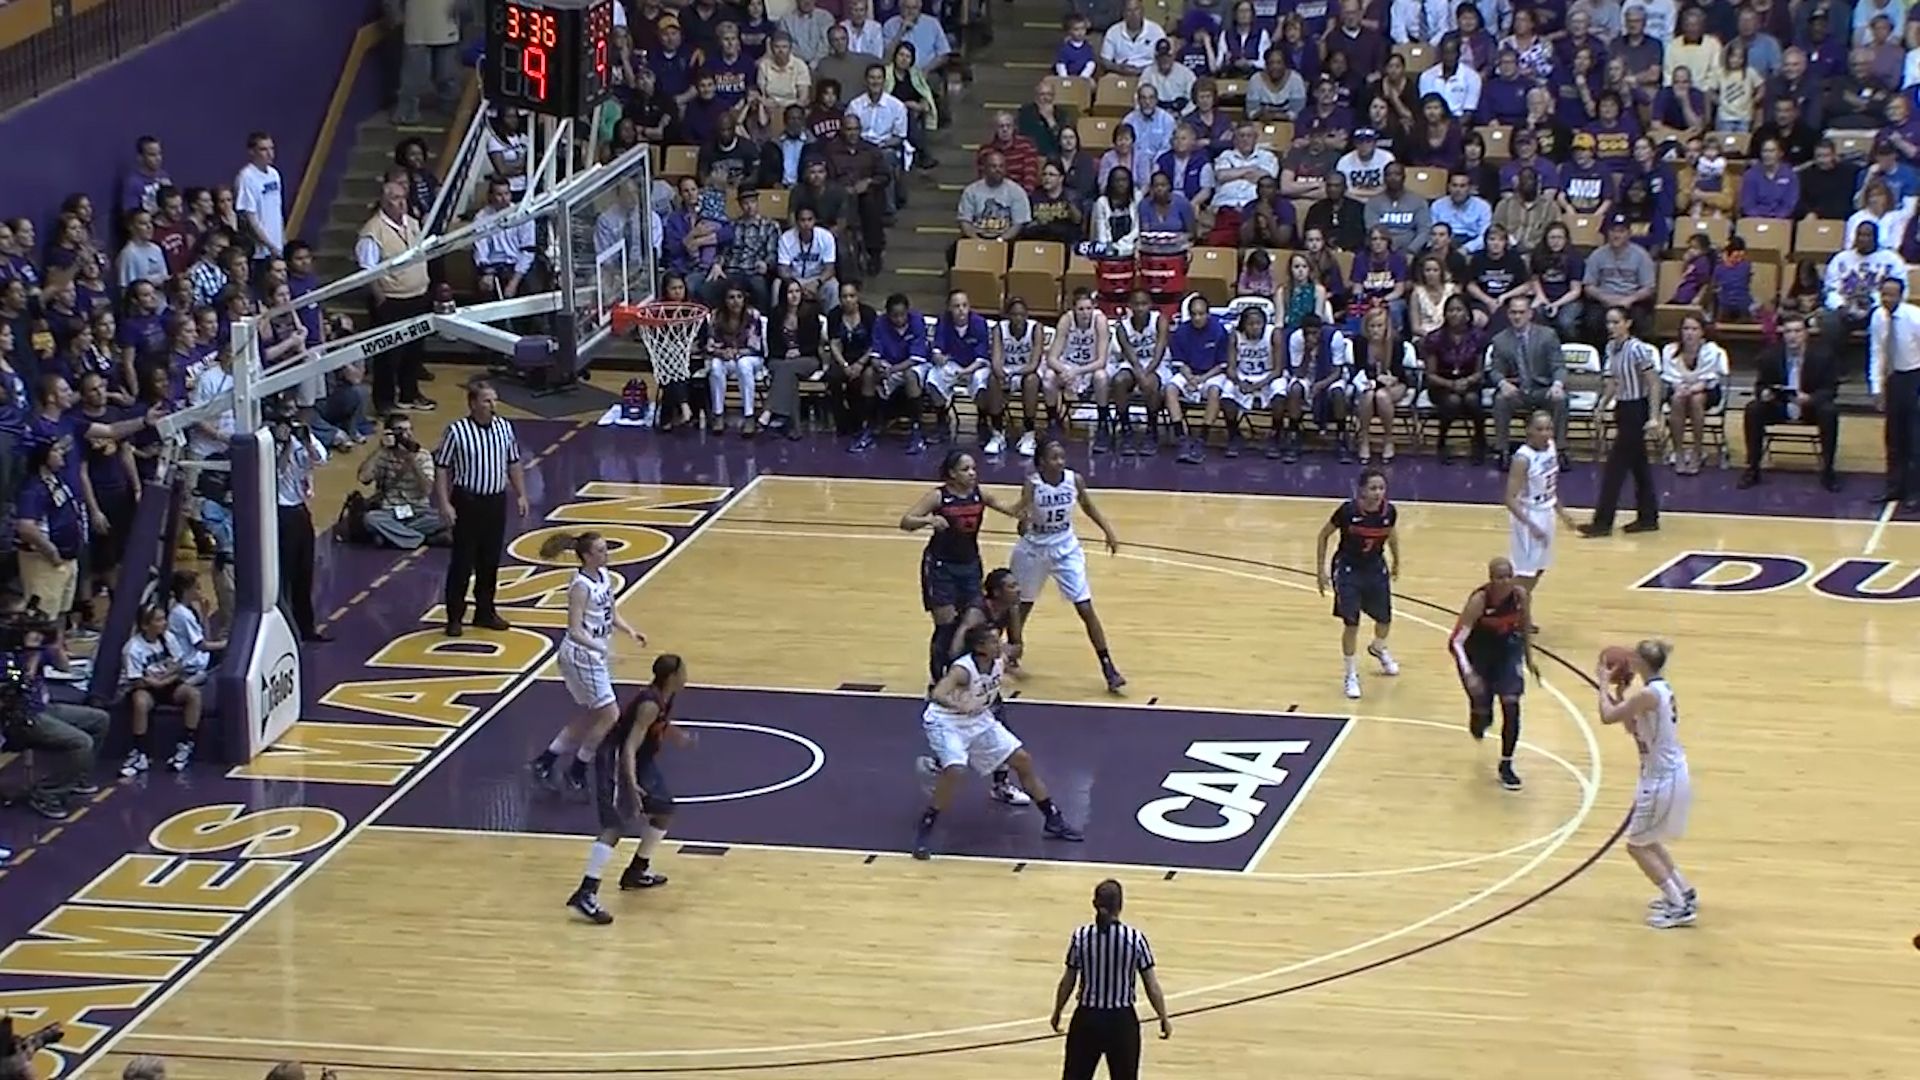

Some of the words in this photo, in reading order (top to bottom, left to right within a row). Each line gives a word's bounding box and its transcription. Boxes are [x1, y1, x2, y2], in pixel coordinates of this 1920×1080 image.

[507, 6, 556, 47] 3:36
[523, 46, 546, 99] 9
[1380, 212, 1414, 224] JMU
[1038, 492, 1072, 507] JAMES
[1047, 509, 1065, 522] 15
[226, 481, 735, 786] MADISON
[1136, 740, 1311, 842] CAA
